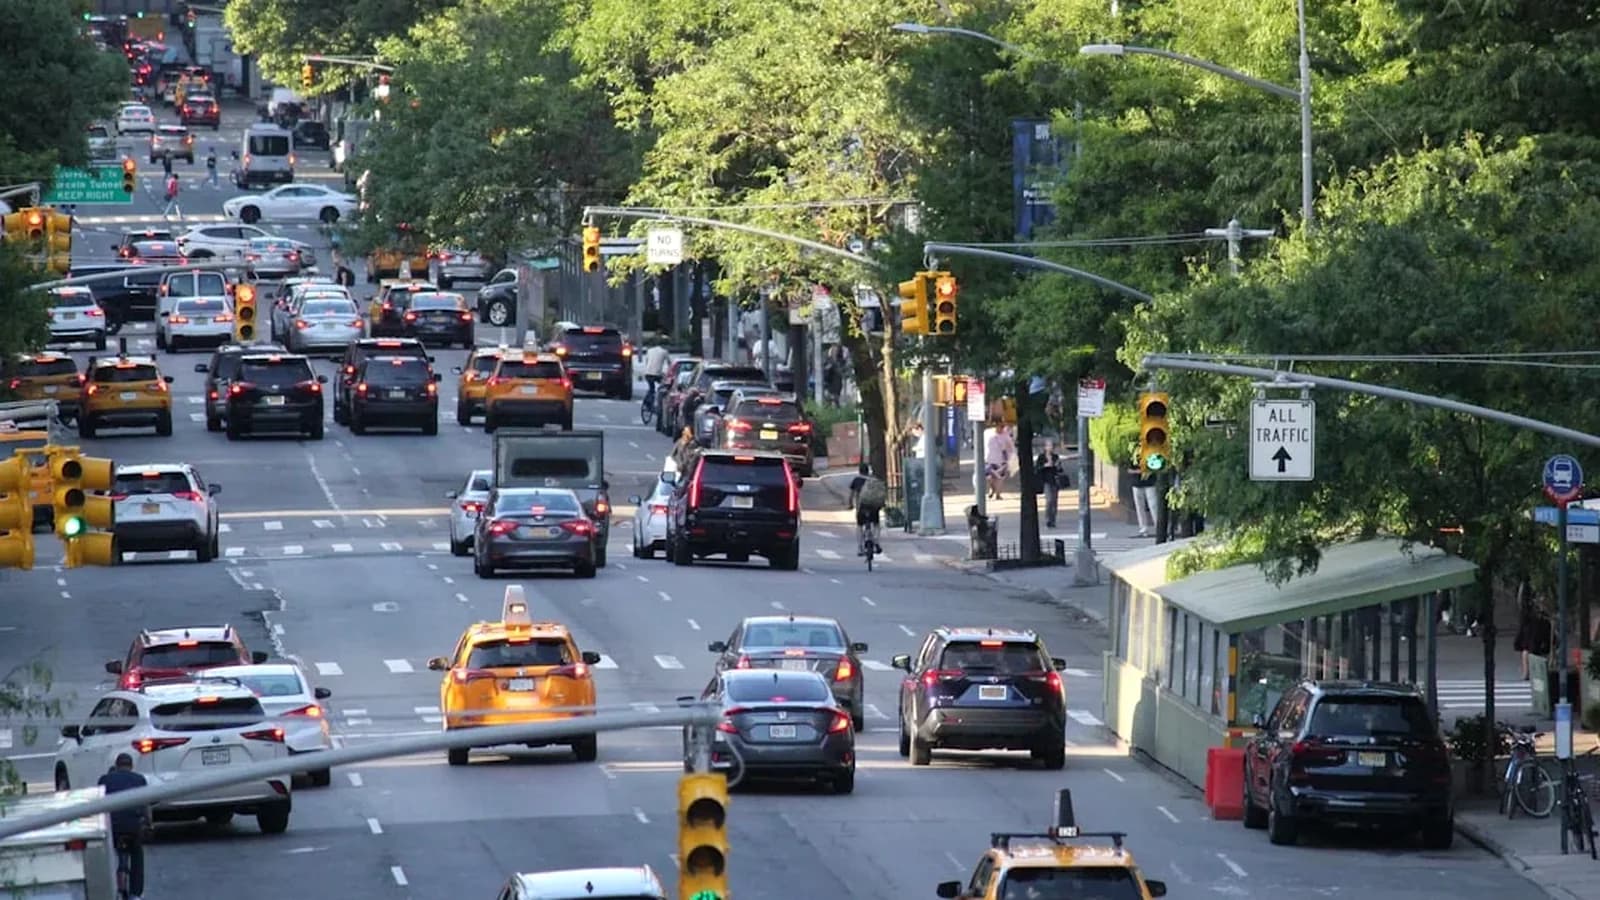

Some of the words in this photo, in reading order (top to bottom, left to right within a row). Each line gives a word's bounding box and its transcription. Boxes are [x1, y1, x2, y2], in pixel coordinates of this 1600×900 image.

[57, 191, 84, 200] KEEP
[86, 191, 115, 200] RIGHT
[657, 235, 672, 245] NO
[650, 248, 680, 258] TURNS
[1269, 408, 1296, 423] ALL
[1256, 428, 1309, 442] TRAFFIC
